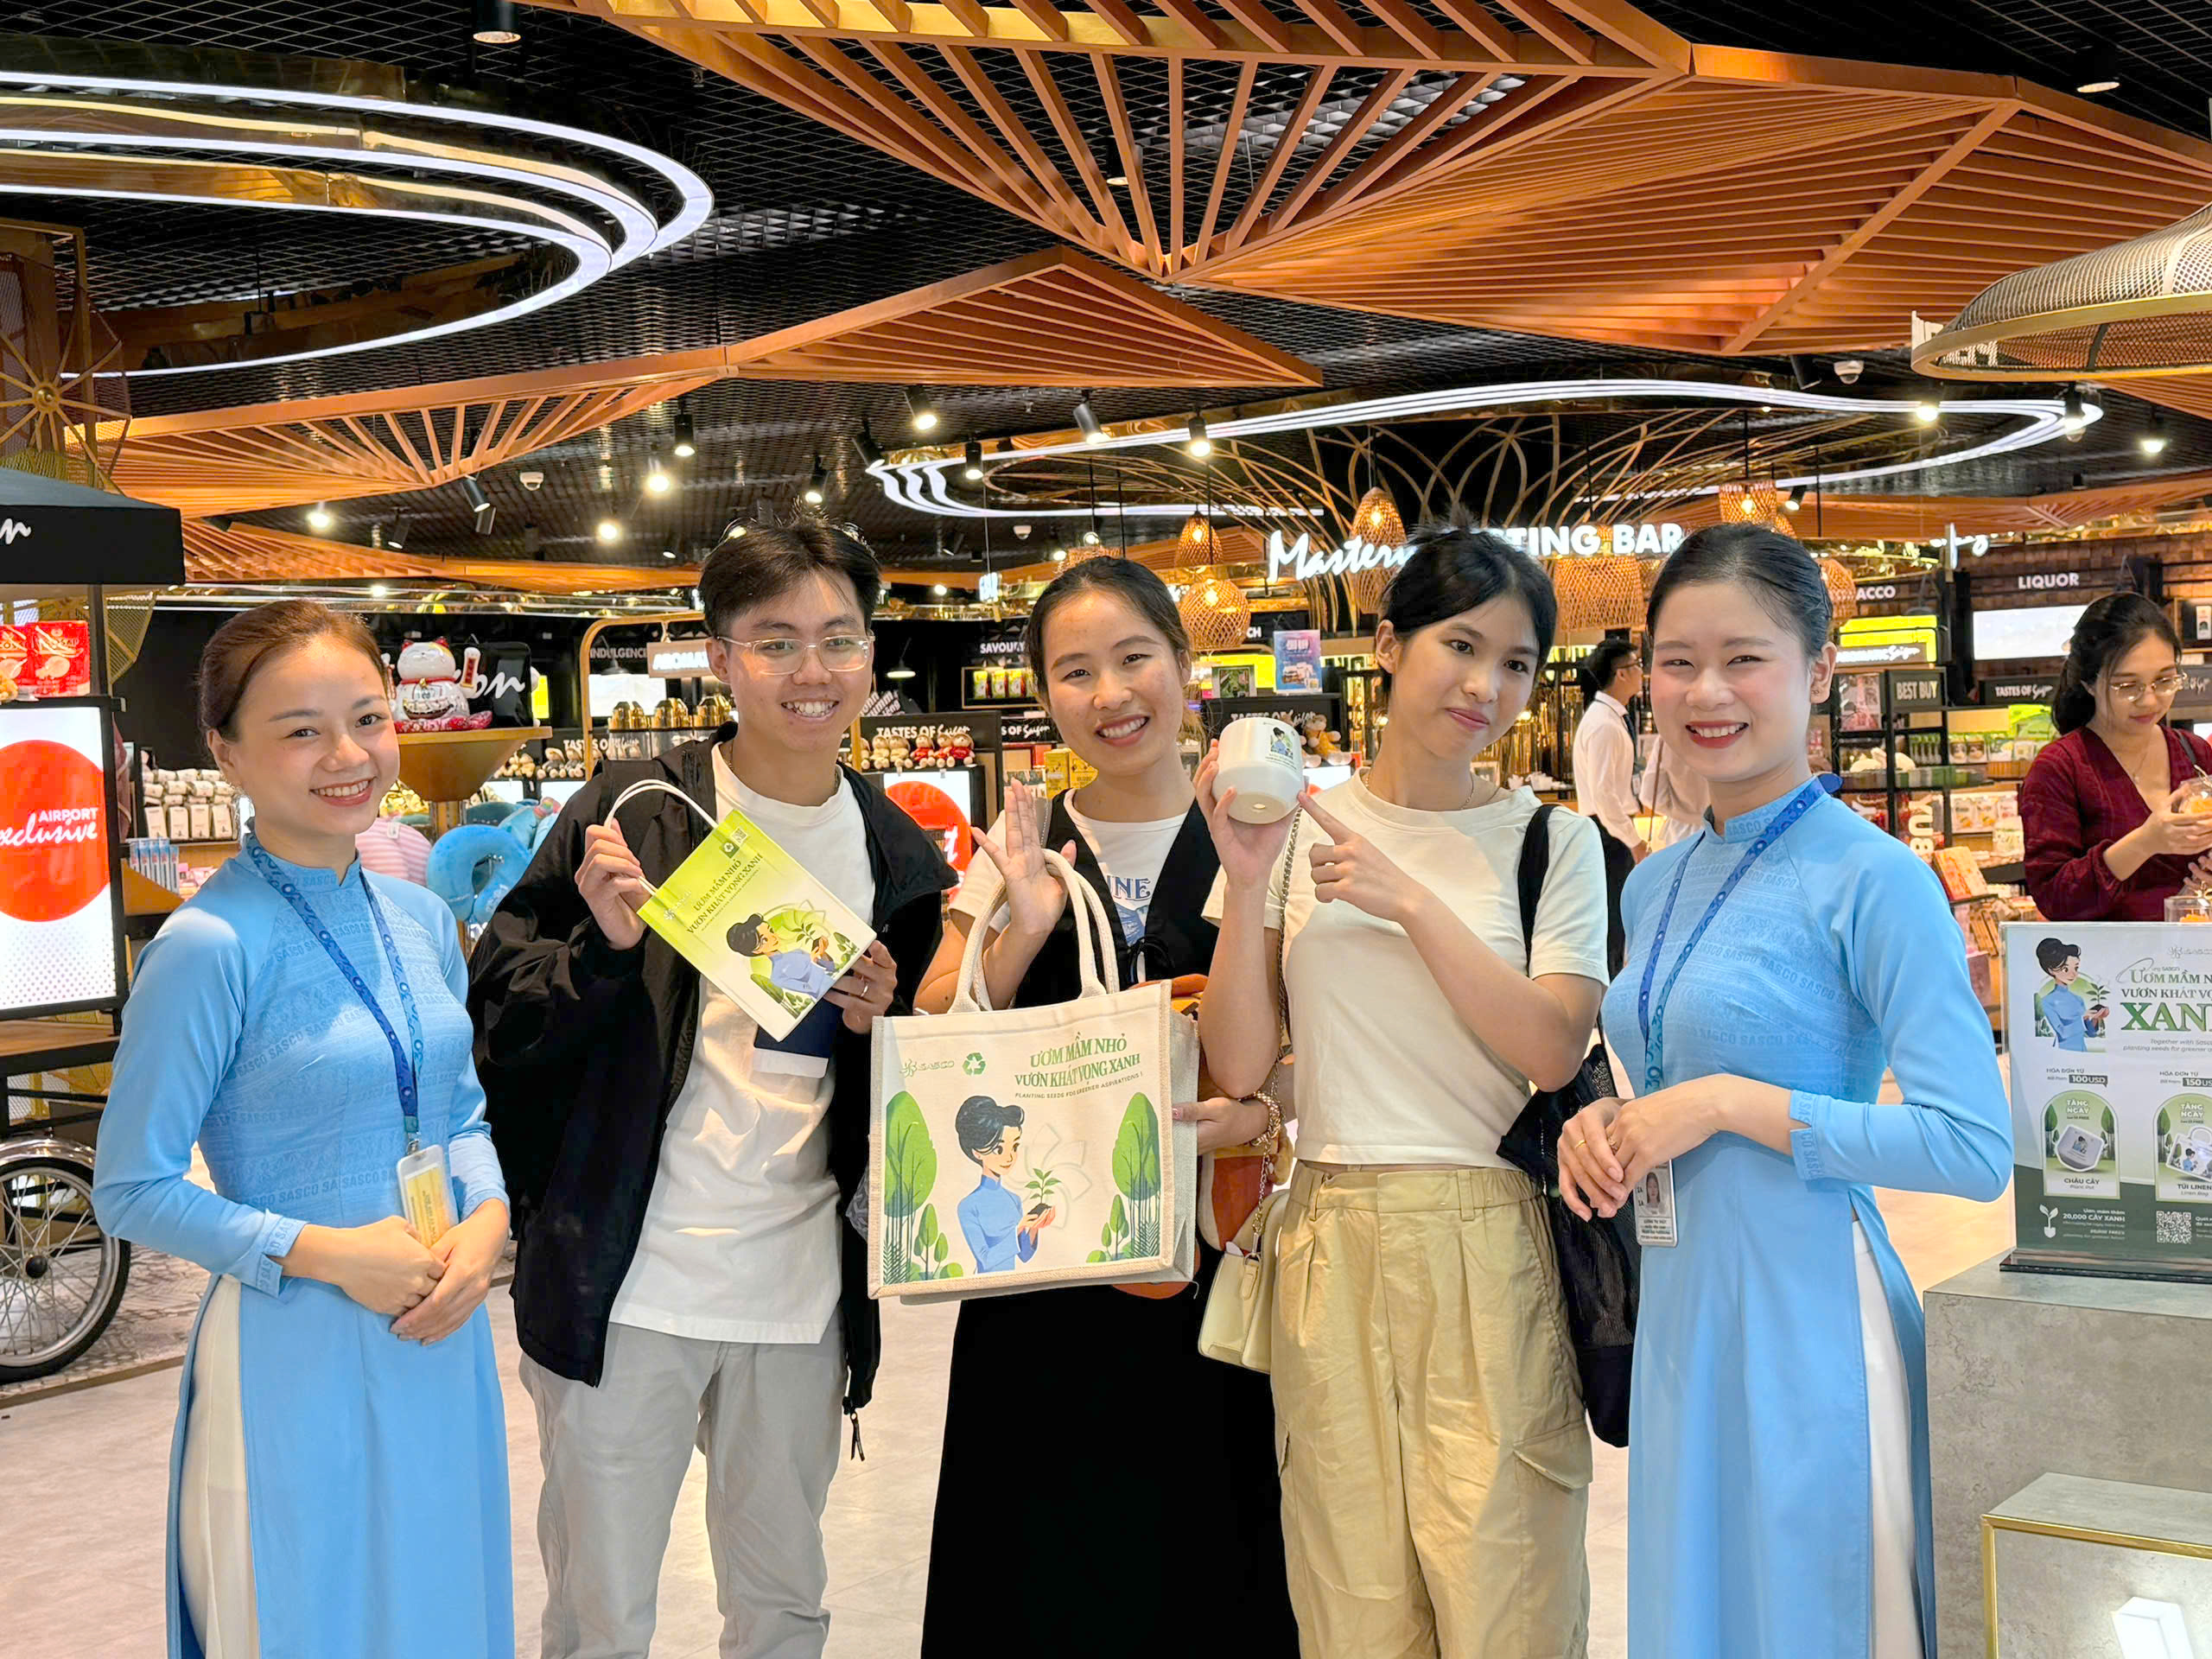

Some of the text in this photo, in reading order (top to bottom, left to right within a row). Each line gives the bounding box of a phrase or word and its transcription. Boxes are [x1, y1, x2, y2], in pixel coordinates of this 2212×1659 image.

[1506, 525, 1600, 556] TING
[1613, 523, 1683, 554] BAR
[2018, 573, 2079, 589] LIQUOR
[1857, 587, 1896, 600] ACCO
[980, 641, 1026, 654] SAVOURY
[1896, 681, 1938, 700] BEST BUY
[1995, 685, 2019, 697] TASTES
[2020, 685, 2031, 696] OF
[876, 727, 918, 740] TASTES
[918, 726, 936, 739] OF
[1007, 727, 1022, 735] OF
[38, 807, 99, 823] AIRPORT
[1759, 953, 1798, 983] SASCO
[1799, 976, 1835, 1001] SASCO
[2130, 967, 2165, 984] ƯƠM
[2168, 969, 2200, 984] MẦM
[2121, 988, 2158, 998] VƯƠN
[2161, 986, 2196, 998] KHÁT
[2120, 1002, 2212, 1033] XAN
[269, 1033, 302, 1058] SASCO
[1030, 1032, 1127, 1068] ƯƠM MẦM NHỎ
[1014, 1053, 1141, 1088] VƯƠN KHÁT VỌNG XANH
[2185, 1078, 2212, 1087] 150US
[278, 1184, 319, 1204] SASCO
